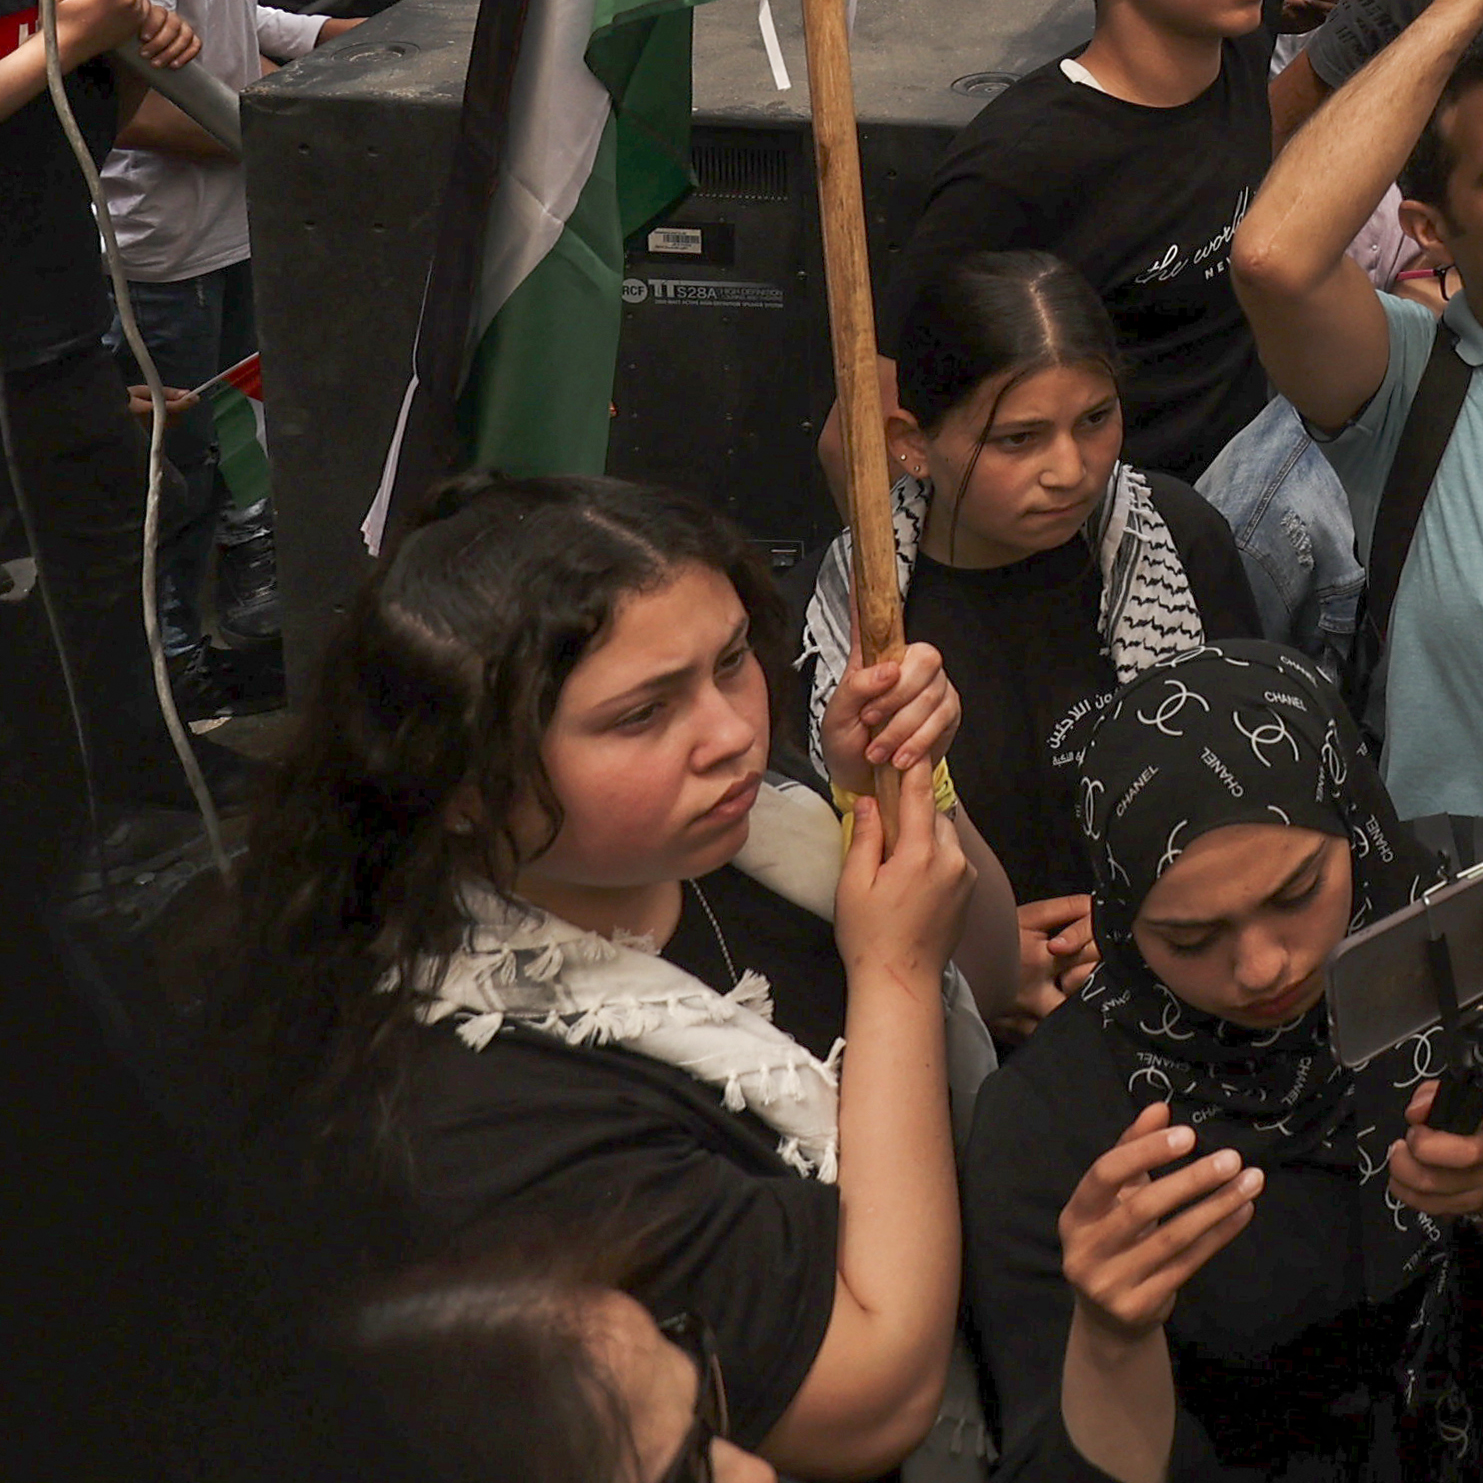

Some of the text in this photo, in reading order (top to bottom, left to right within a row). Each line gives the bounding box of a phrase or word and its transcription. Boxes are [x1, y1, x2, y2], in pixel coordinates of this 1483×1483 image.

[677, 287, 718, 300] S28A
[1046, 699, 1092, 749] اللاجئين
[1263, 690, 1308, 713] CHANEL
[1115, 766, 1160, 818] CHANEL
[1200, 746, 1244, 798] CHANEL
[1364, 814, 1394, 864] CHANEL
[1280, 1057, 1313, 1106] CHANEL
